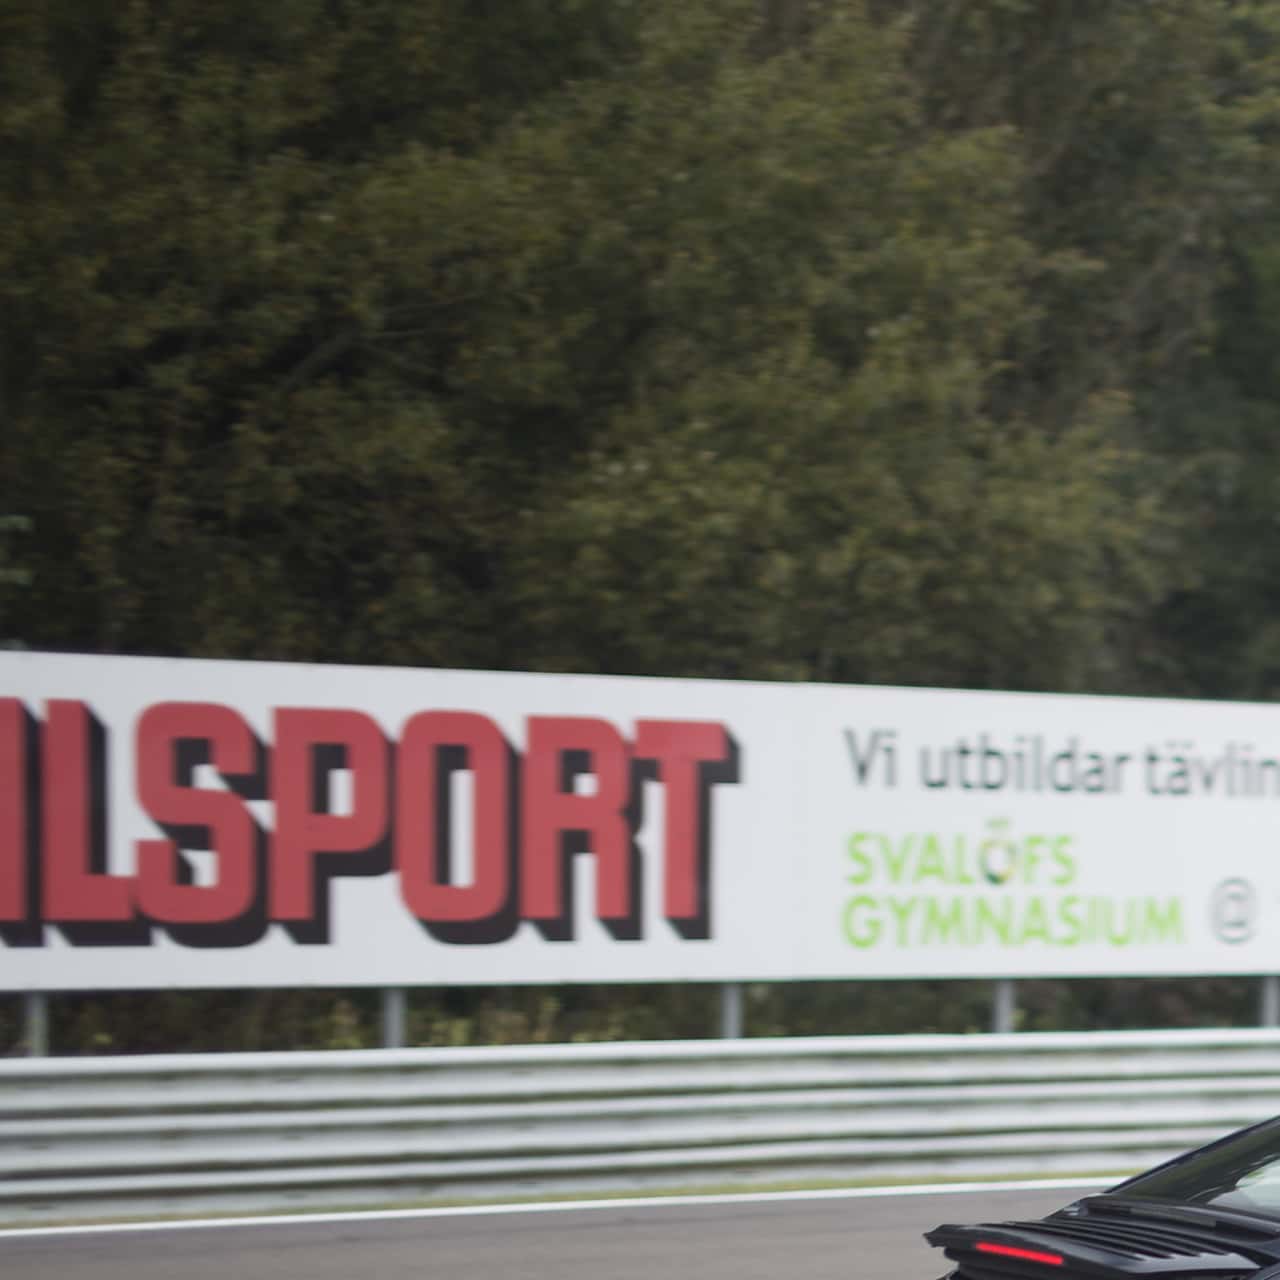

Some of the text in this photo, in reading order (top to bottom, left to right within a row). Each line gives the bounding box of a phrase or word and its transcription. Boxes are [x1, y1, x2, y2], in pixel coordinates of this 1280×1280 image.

[843, 729, 897, 788] Vi
[919, 734, 1131, 794] utbildar
[846, 816, 1077, 886] SVALÖFS
[841, 895, 1186, 948] GYMNASIUM
